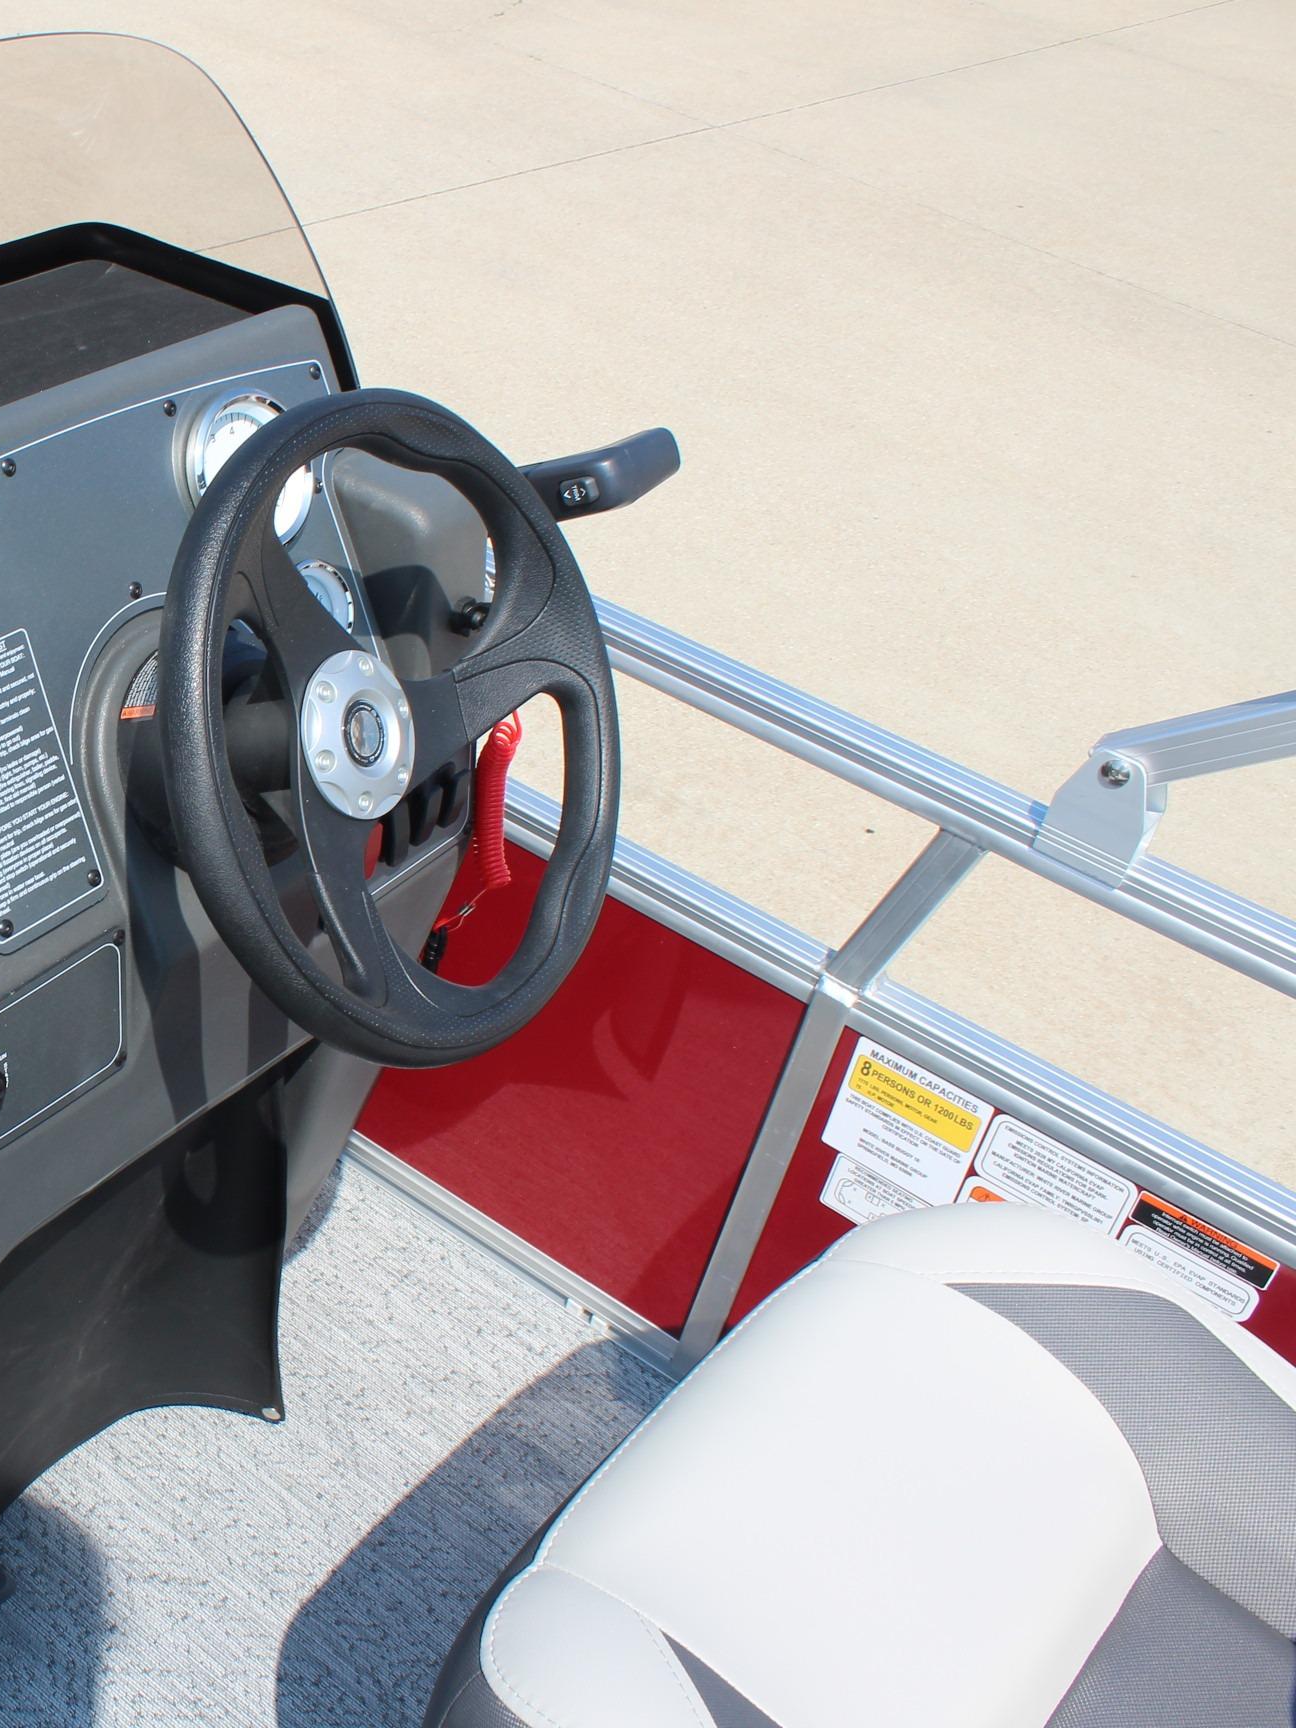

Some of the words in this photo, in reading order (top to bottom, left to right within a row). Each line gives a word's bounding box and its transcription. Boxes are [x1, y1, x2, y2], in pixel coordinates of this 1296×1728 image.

[859, 1059, 872, 1077] 8
[870, 1069, 916, 1099] PERSONS
[916, 1093, 932, 1108] OR
[932, 1103, 954, 1120] 1200
[953, 1113, 974, 1131] LBS
[868, 1048, 918, 1080] MAXIMUM
[918, 1075, 979, 1114] CAPACITIES
[1190, 1219, 1238, 1249] WARNING
